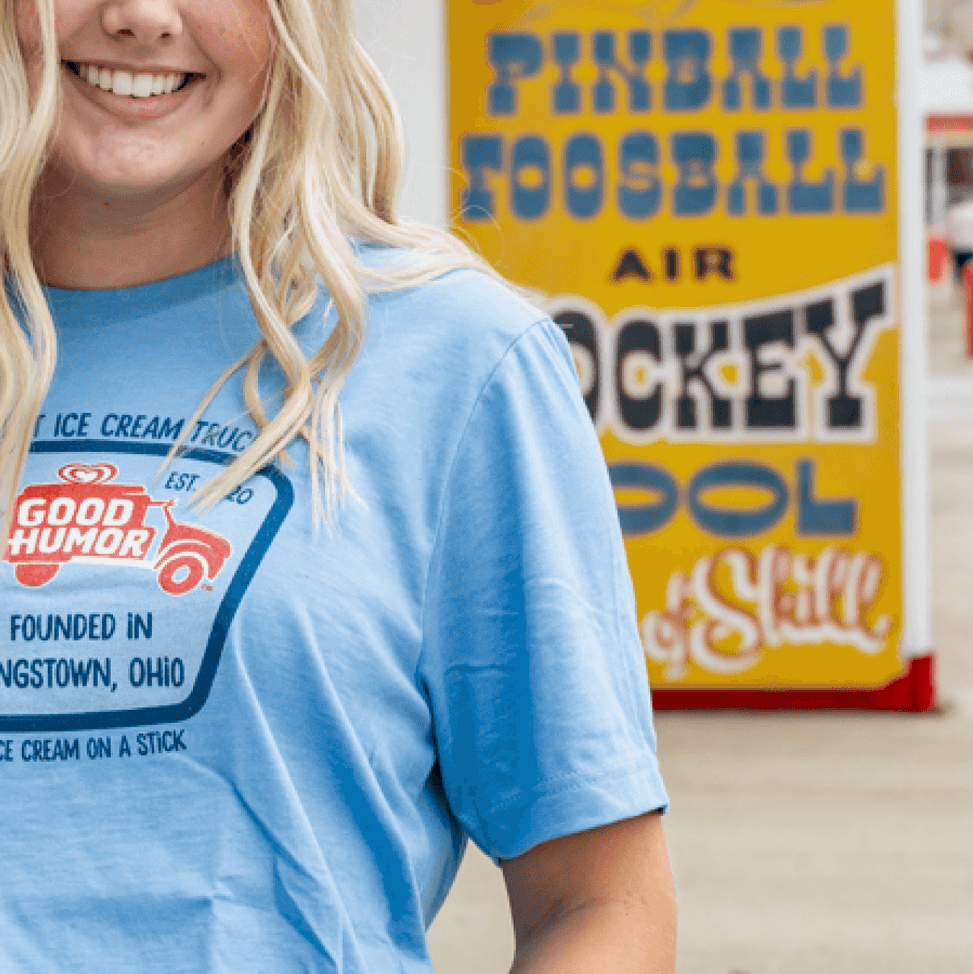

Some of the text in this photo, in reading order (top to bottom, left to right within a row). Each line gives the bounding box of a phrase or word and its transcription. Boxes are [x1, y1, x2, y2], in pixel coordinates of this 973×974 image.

[487, 25, 864, 116] PINBALL
[461, 128, 887, 222] FOOSBALL
[610, 247, 735, 282] AIR
[548, 278, 887, 433] OCKEY
[54, 412, 94, 439] ICE
[101, 412, 185, 441] CREAM
[190, 419, 253, 452] TRUC
[18, 497, 134, 526] GOOD
[606, 457, 858, 539] OOL
[8, 526, 149, 557] HUMOR
[9, 613, 117, 641] FOUNDED
[688, 546, 891, 673] Skill
[21, 737, 80, 762] CREAM
[86, 736, 112, 760] ON
[119, 735, 131, 757] A
